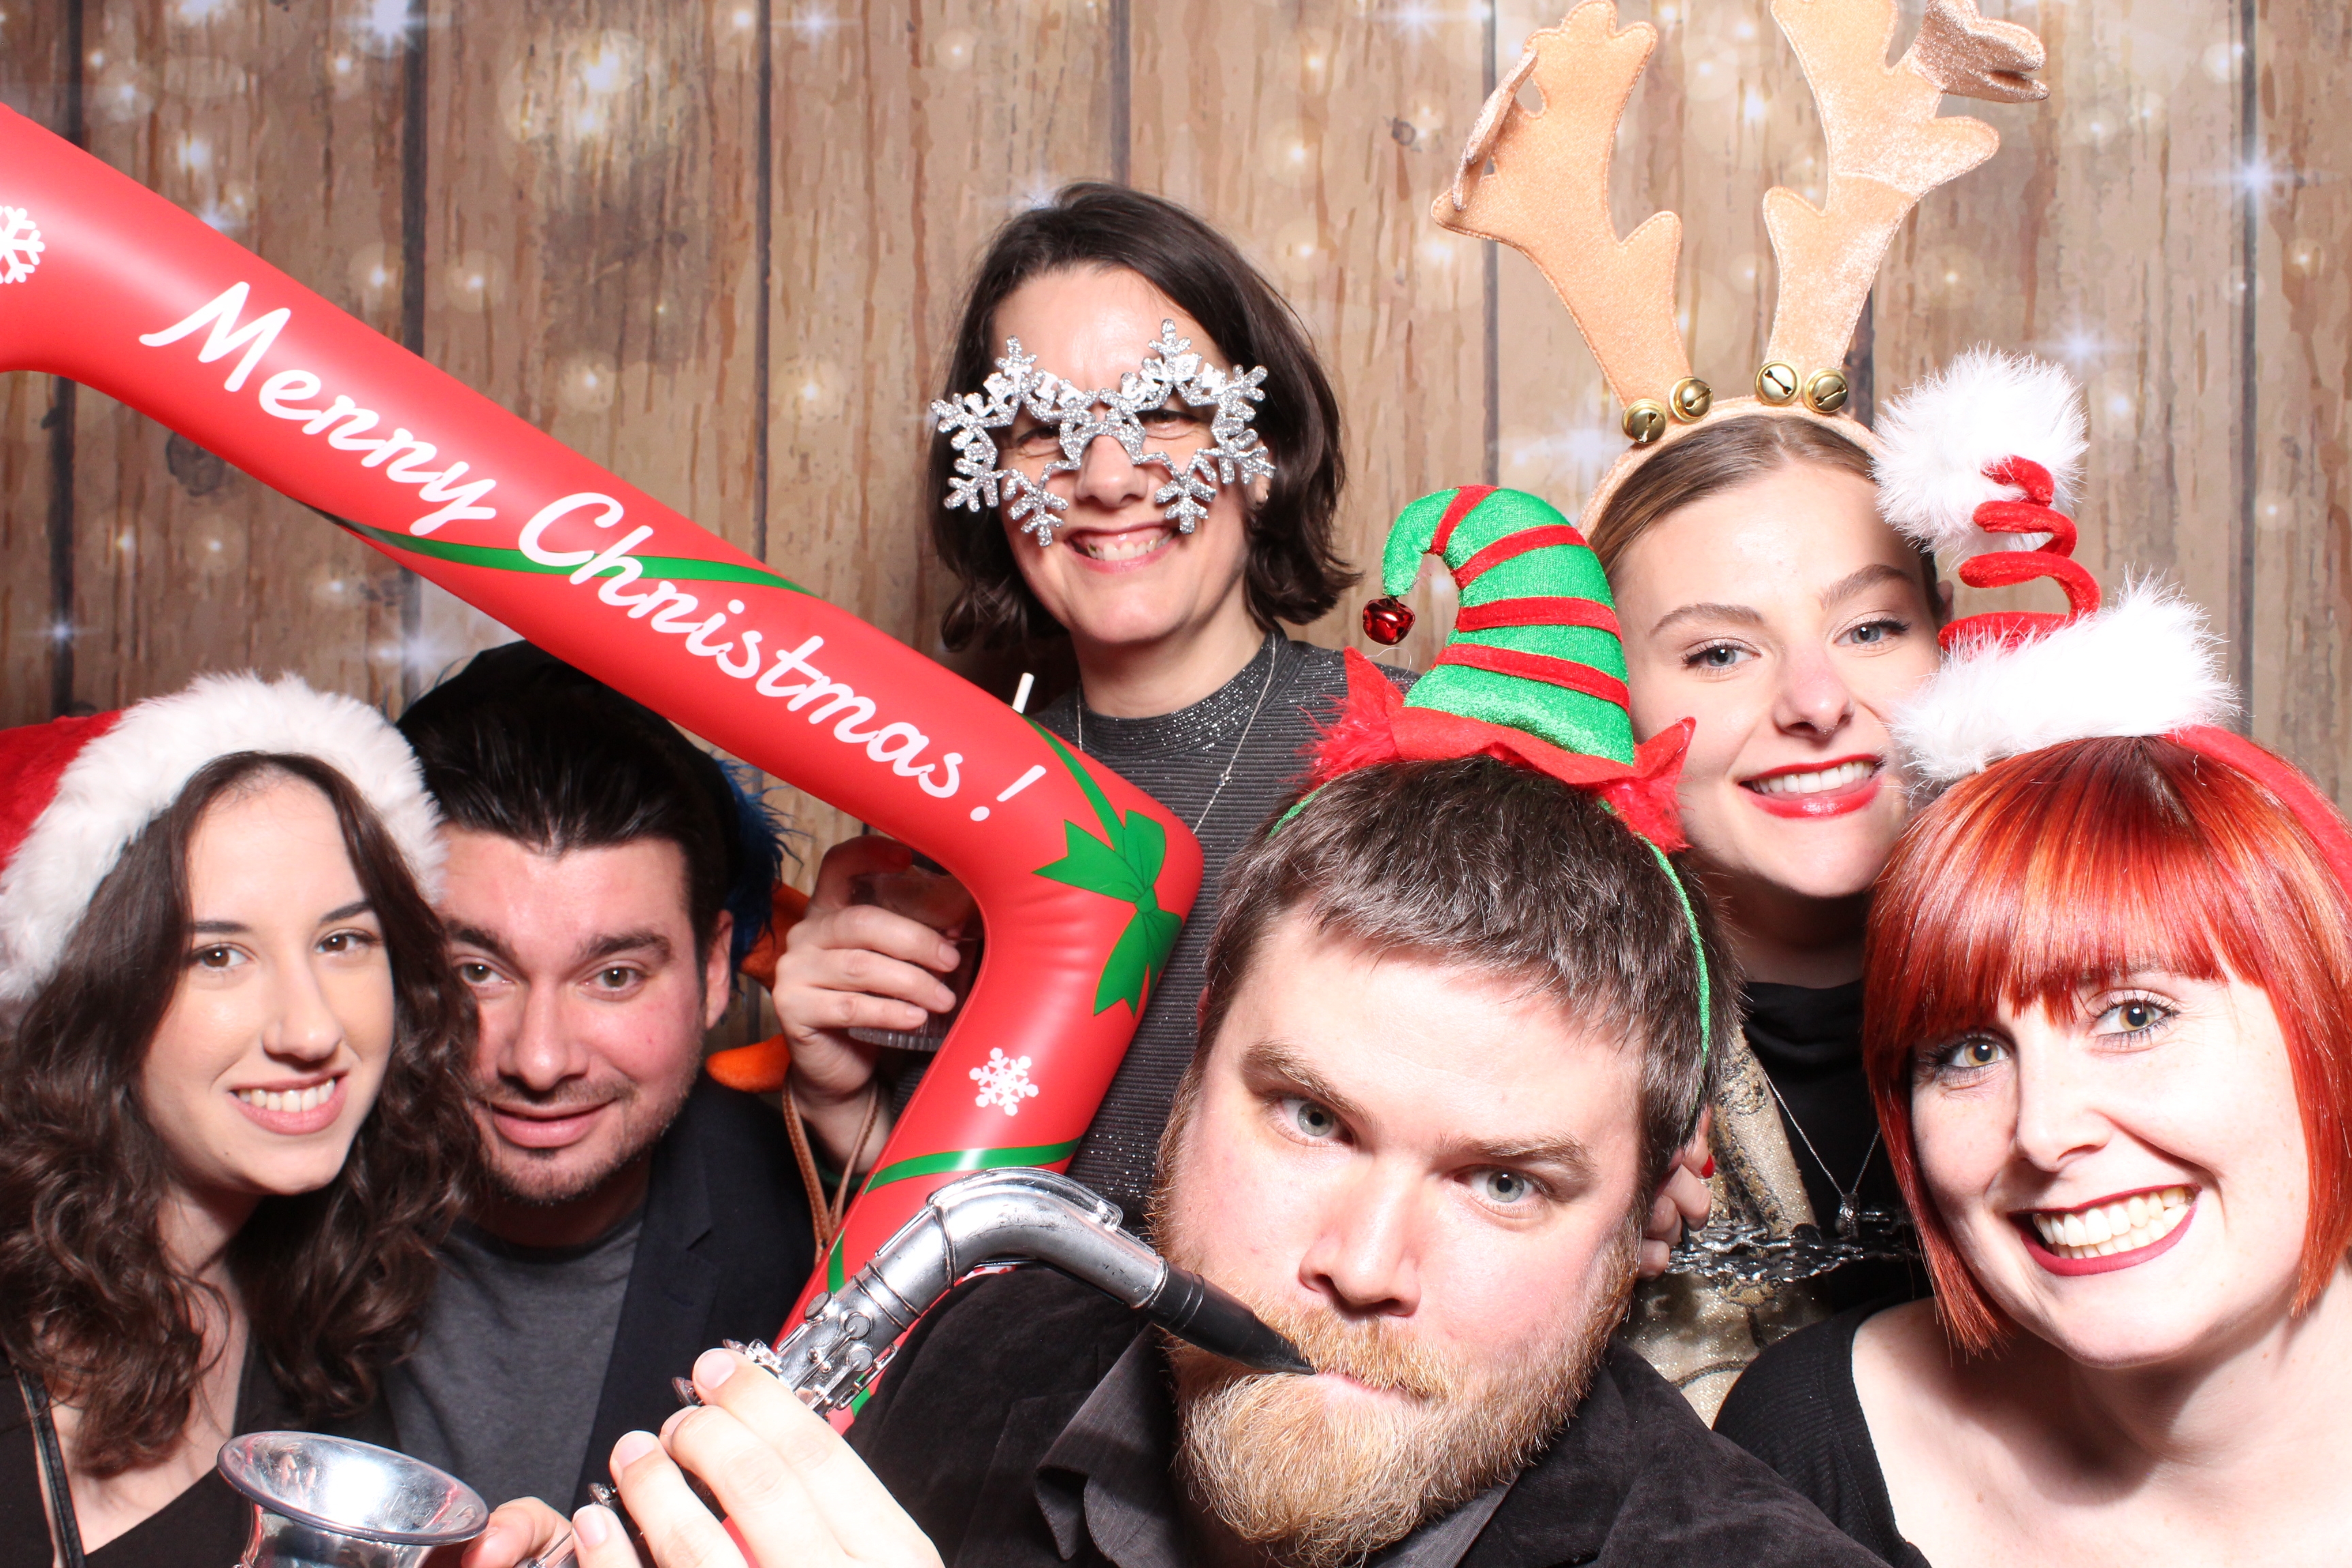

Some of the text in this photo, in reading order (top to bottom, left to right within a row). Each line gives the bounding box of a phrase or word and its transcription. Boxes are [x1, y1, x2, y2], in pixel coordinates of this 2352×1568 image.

[140, 281, 496, 536] Merry
[964, 365, 1032, 417] LET
[1034, 370, 1086, 408] IT
